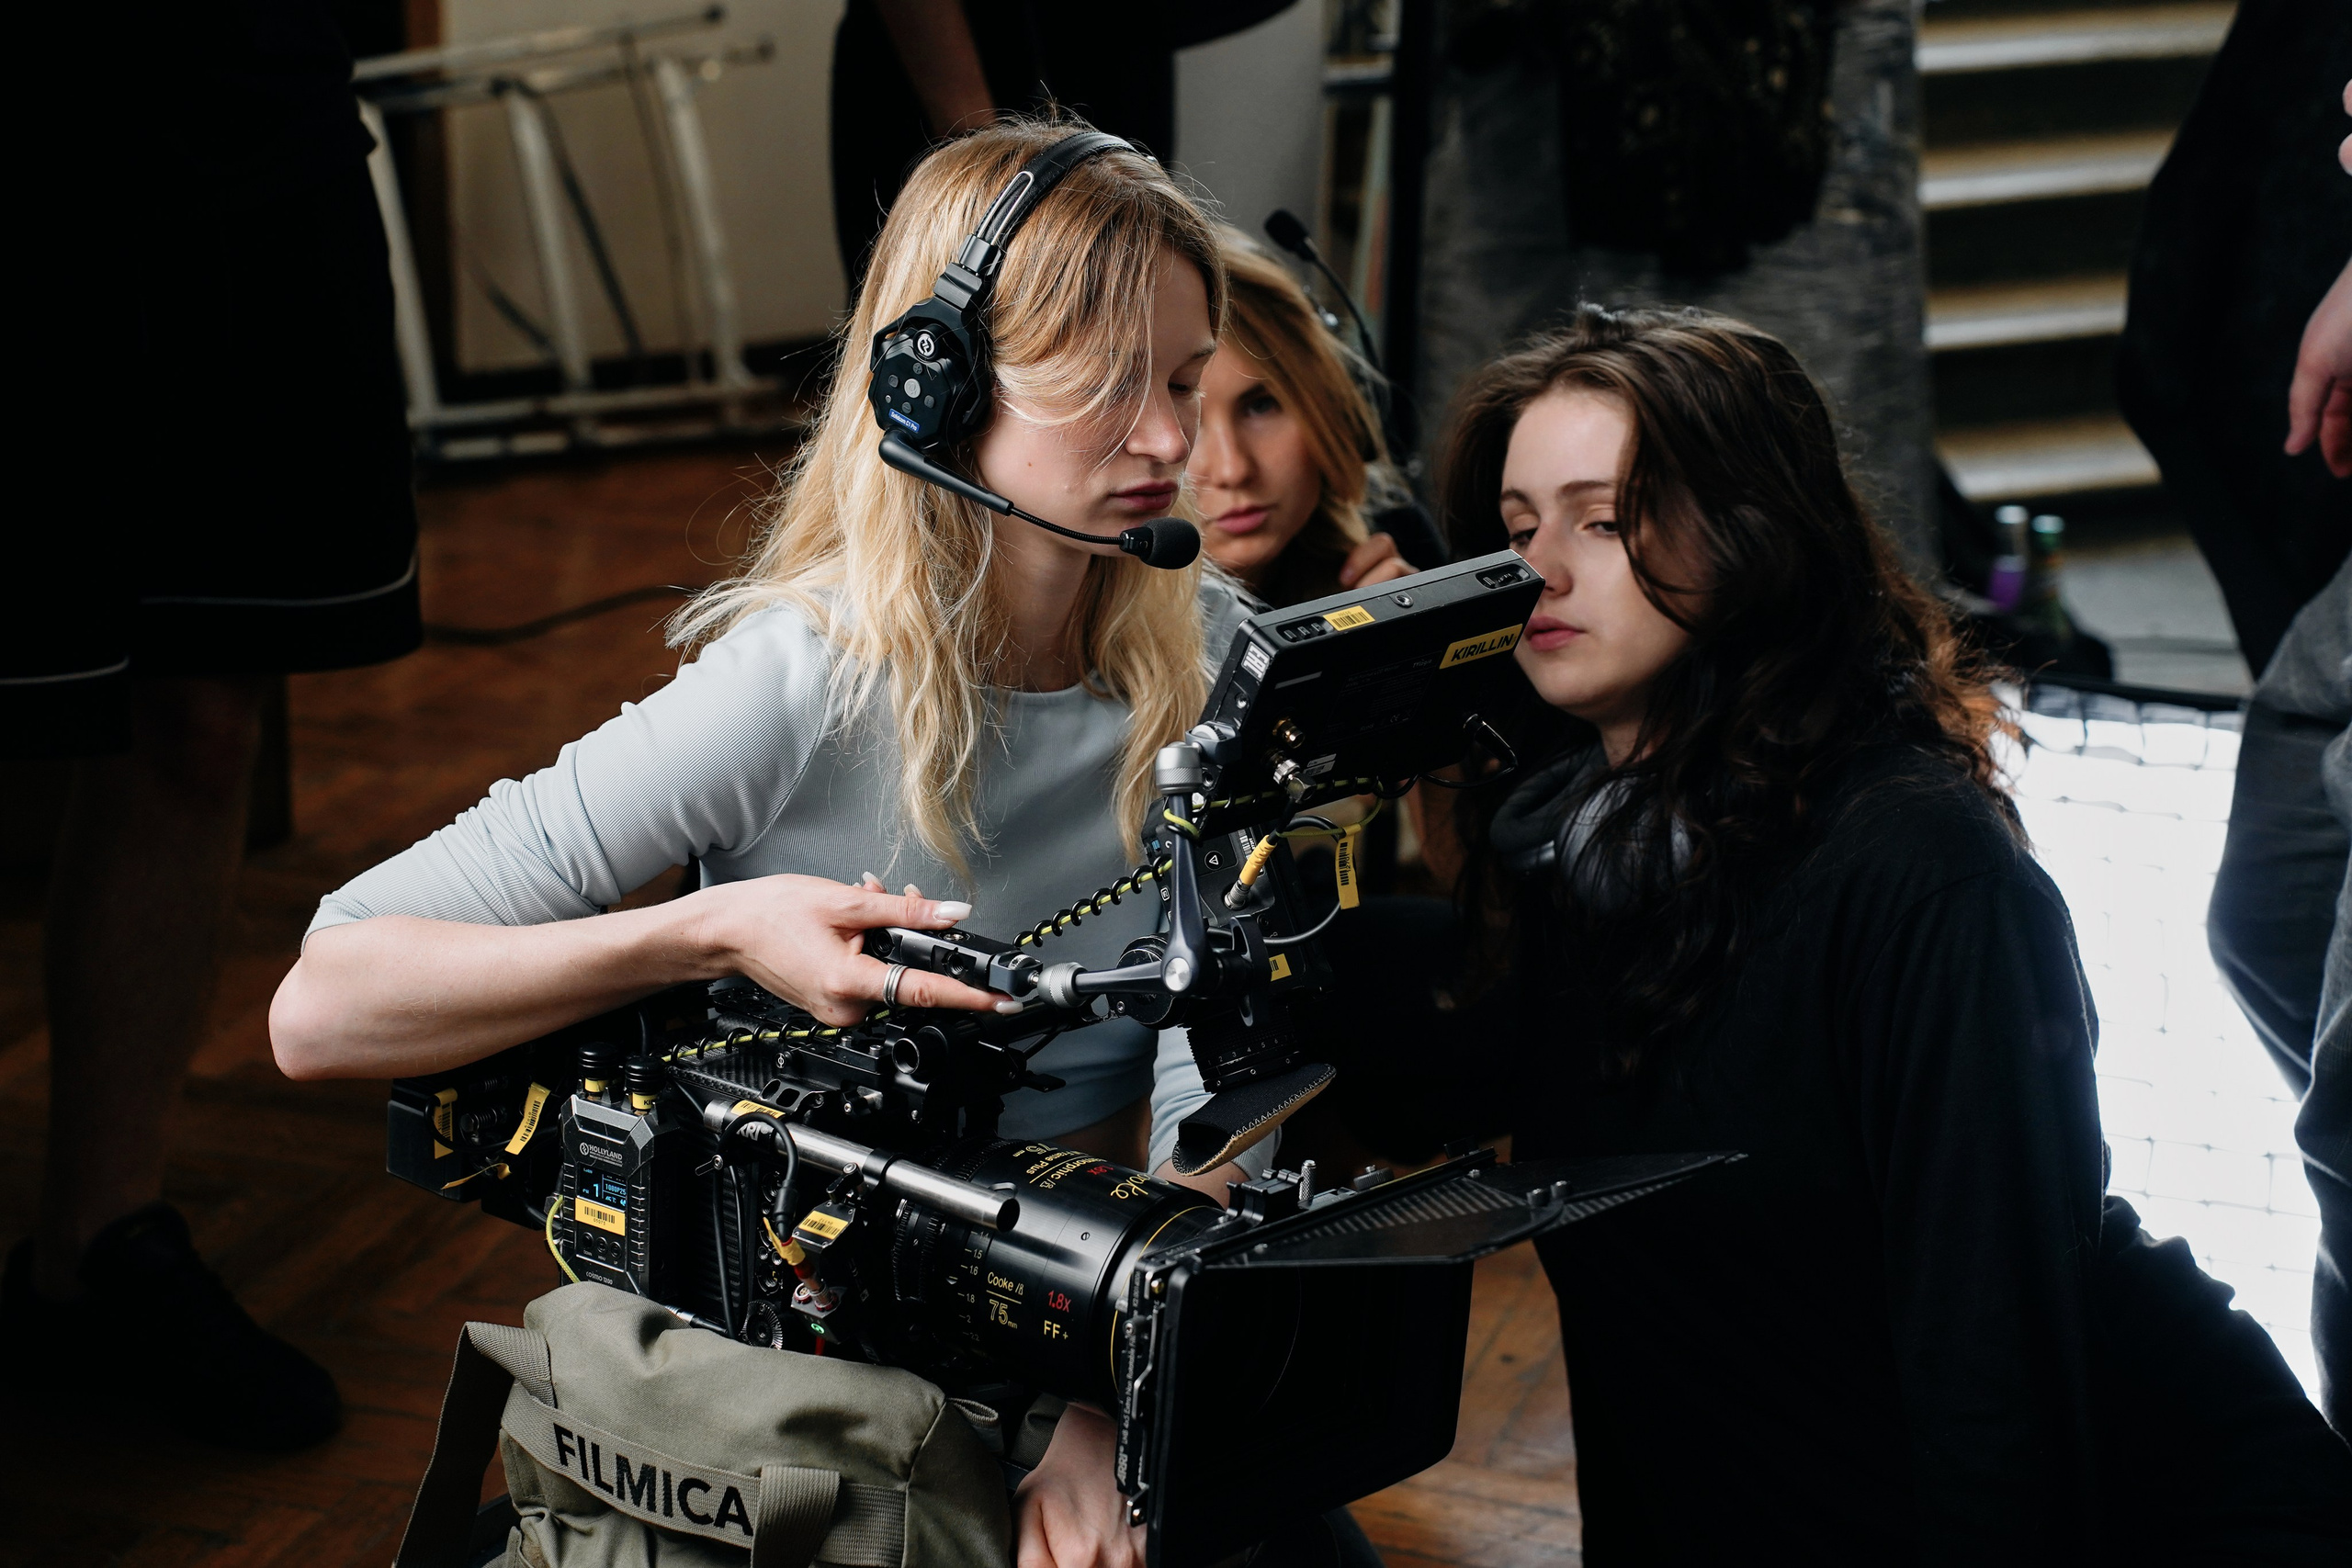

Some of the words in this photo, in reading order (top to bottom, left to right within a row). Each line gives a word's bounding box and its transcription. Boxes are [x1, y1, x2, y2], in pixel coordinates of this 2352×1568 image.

[1451, 634, 1514, 661] KIRILLIN
[589, 1145, 622, 1160] HOLLYLAND
[1026, 1160, 1049, 1175] Plus
[973, 1249, 983, 1259] 1.5
[969, 1266, 978, 1276] 1.6
[987, 1271, 1014, 1292] Cooke
[966, 1292, 976, 1303] 1.8
[1047, 1290, 1072, 1314] 1.8x
[553, 1422, 754, 1537] FILMICA
